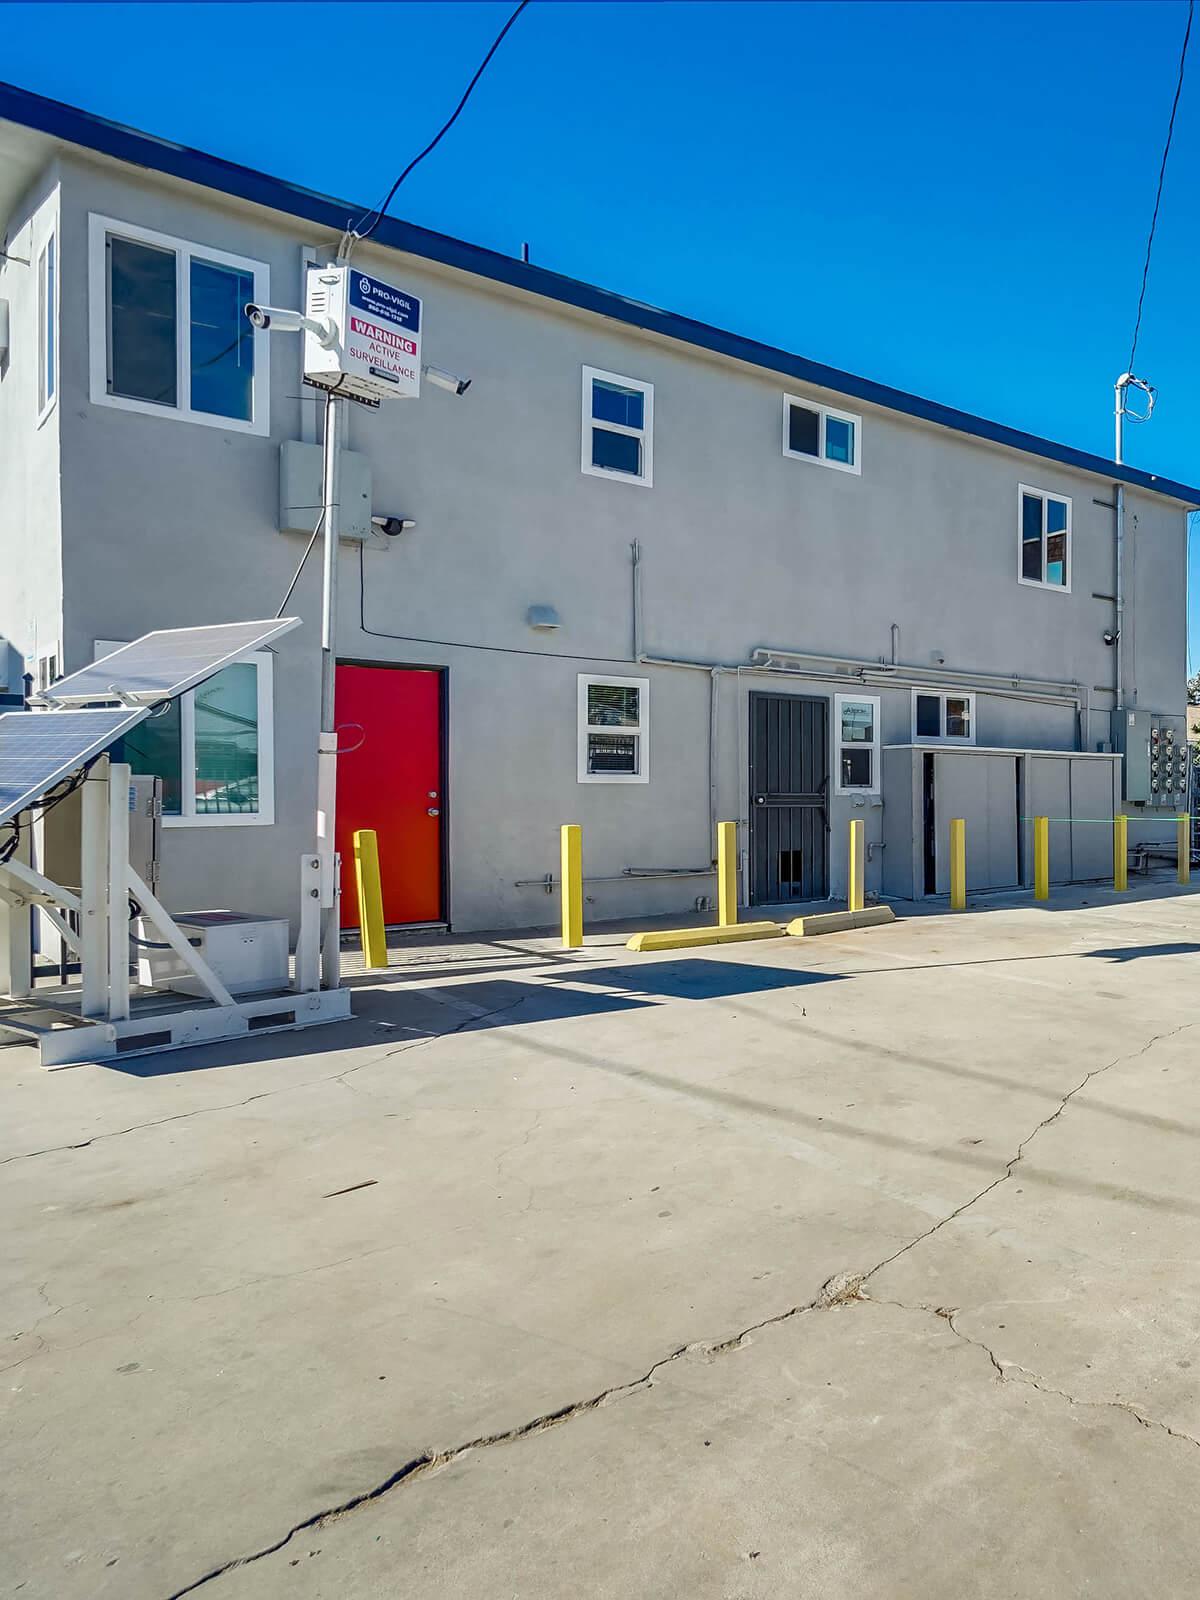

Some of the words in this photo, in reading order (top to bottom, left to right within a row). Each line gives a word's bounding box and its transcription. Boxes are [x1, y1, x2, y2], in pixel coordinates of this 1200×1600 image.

[372, 287, 412, 310] PRO-VIGIL
[354, 319, 413, 352] WARNING
[349, 347, 416, 379] SURVEILLANCE
[369, 342, 400, 361] ACTIVE
